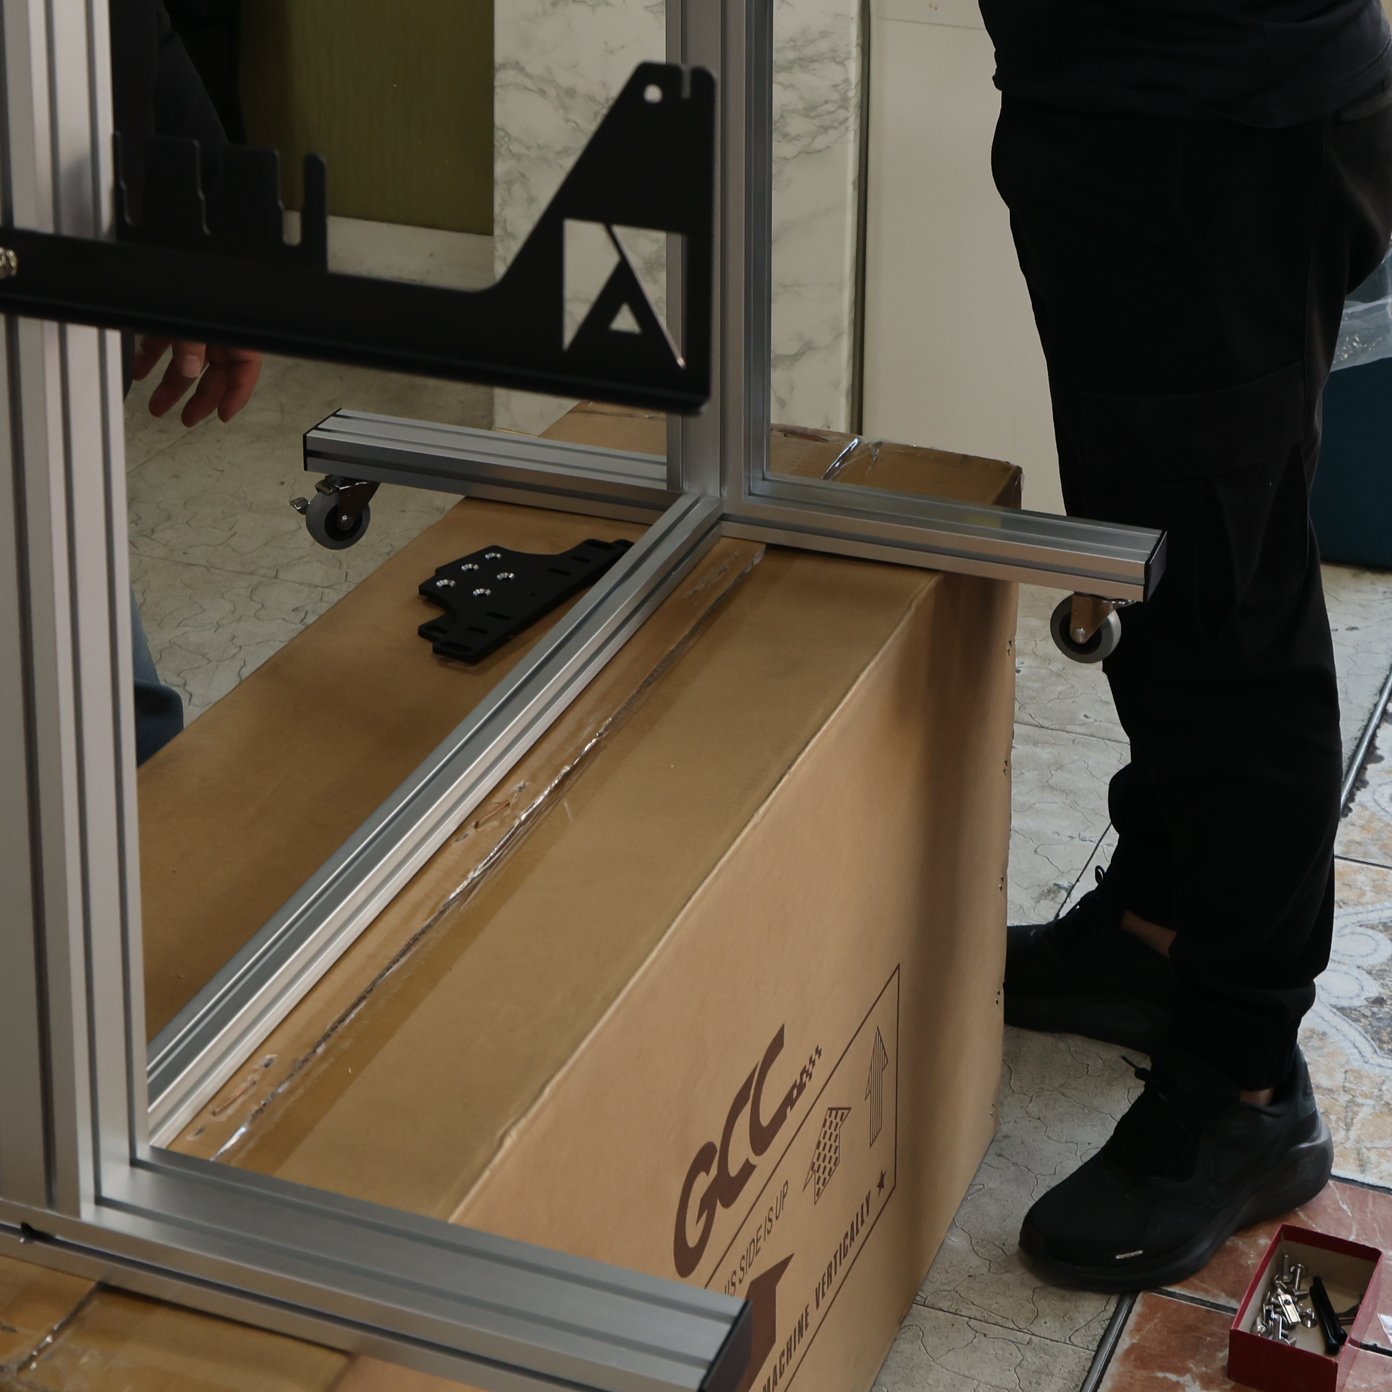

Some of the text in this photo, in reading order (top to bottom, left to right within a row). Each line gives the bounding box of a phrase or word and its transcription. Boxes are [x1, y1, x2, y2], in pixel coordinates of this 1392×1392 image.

[673, 1022, 788, 1279] GCC
[739, 1180, 790, 1284] SIDE IS UP
[814, 1190, 872, 1311] VERTICALLY
